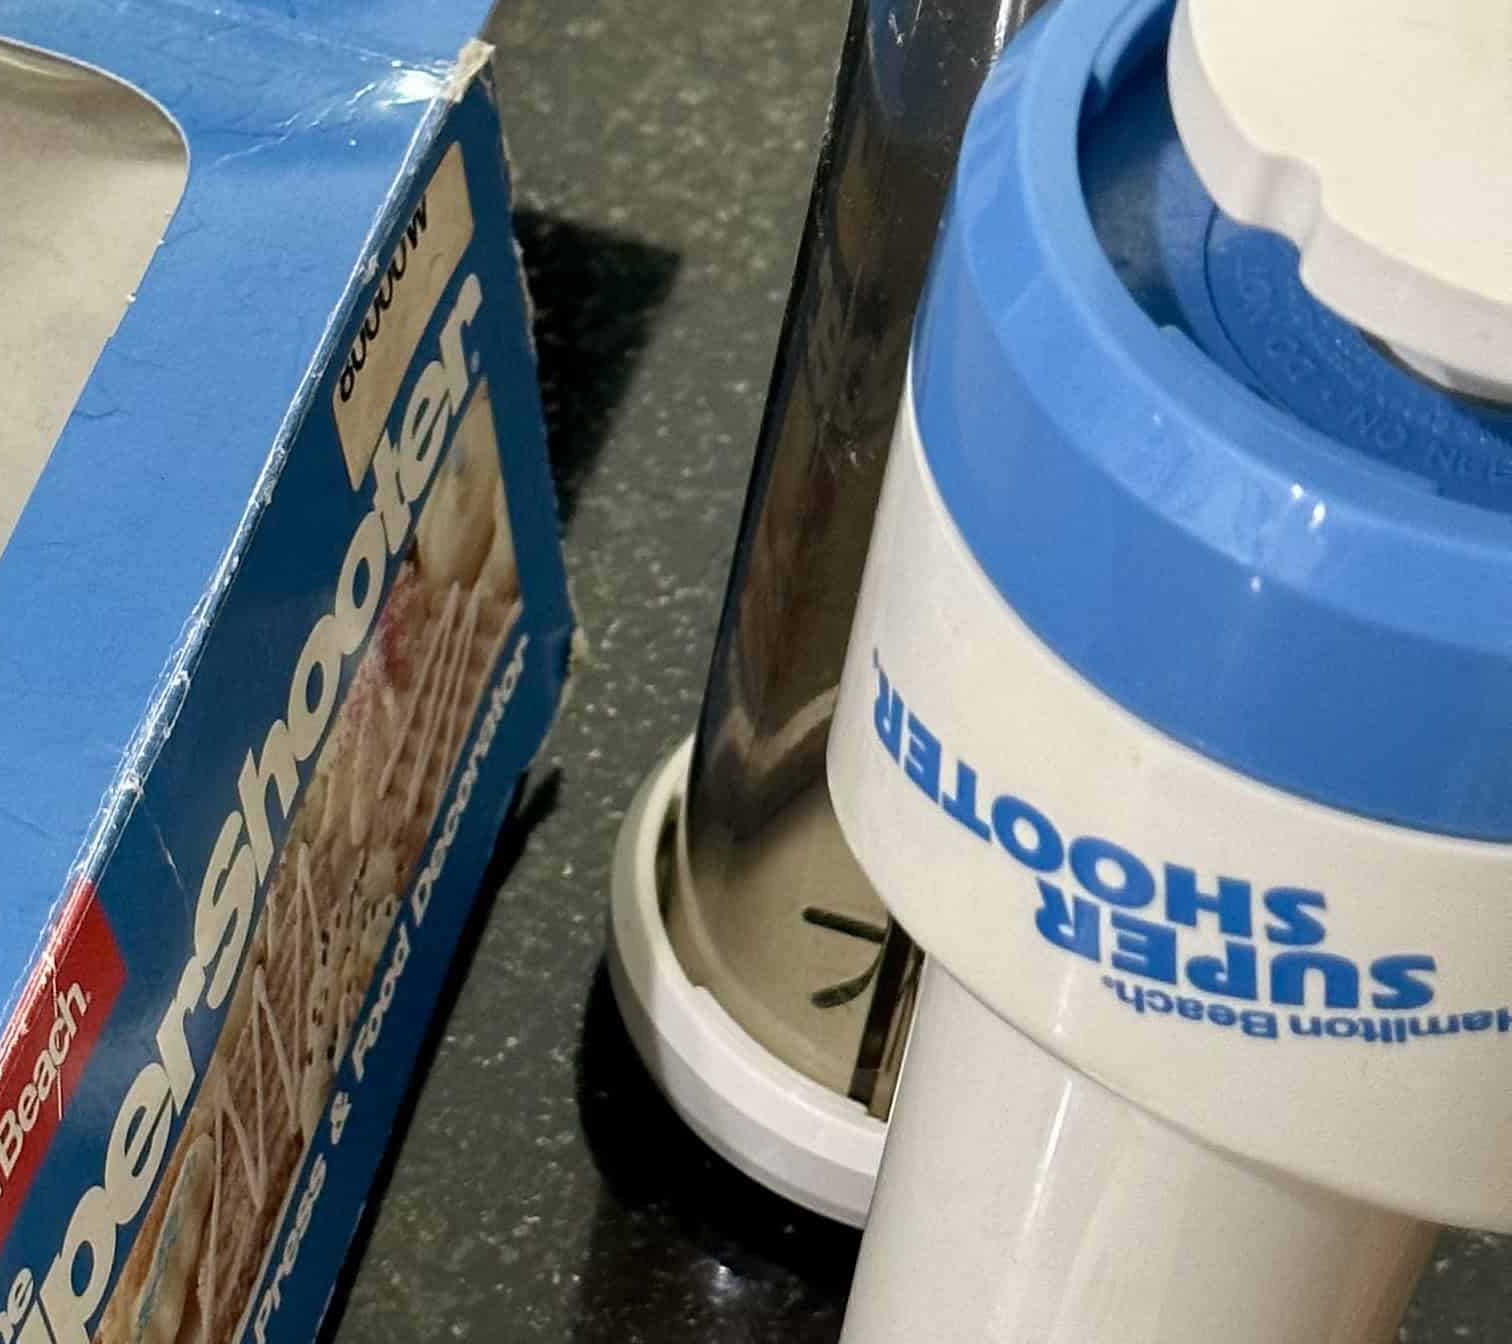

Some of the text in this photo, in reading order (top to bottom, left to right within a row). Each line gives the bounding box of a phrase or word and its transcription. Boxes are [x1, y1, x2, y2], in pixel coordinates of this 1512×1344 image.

[330, 1091, 352, 1145] &
[352, 922, 410, 1082] Food
[411, 633, 530, 927] Decorator
[872, 666, 1328, 947] SHOOTER
[1035, 878, 1436, 1011] SUPER
[1116, 976, 1279, 1041] Beach
